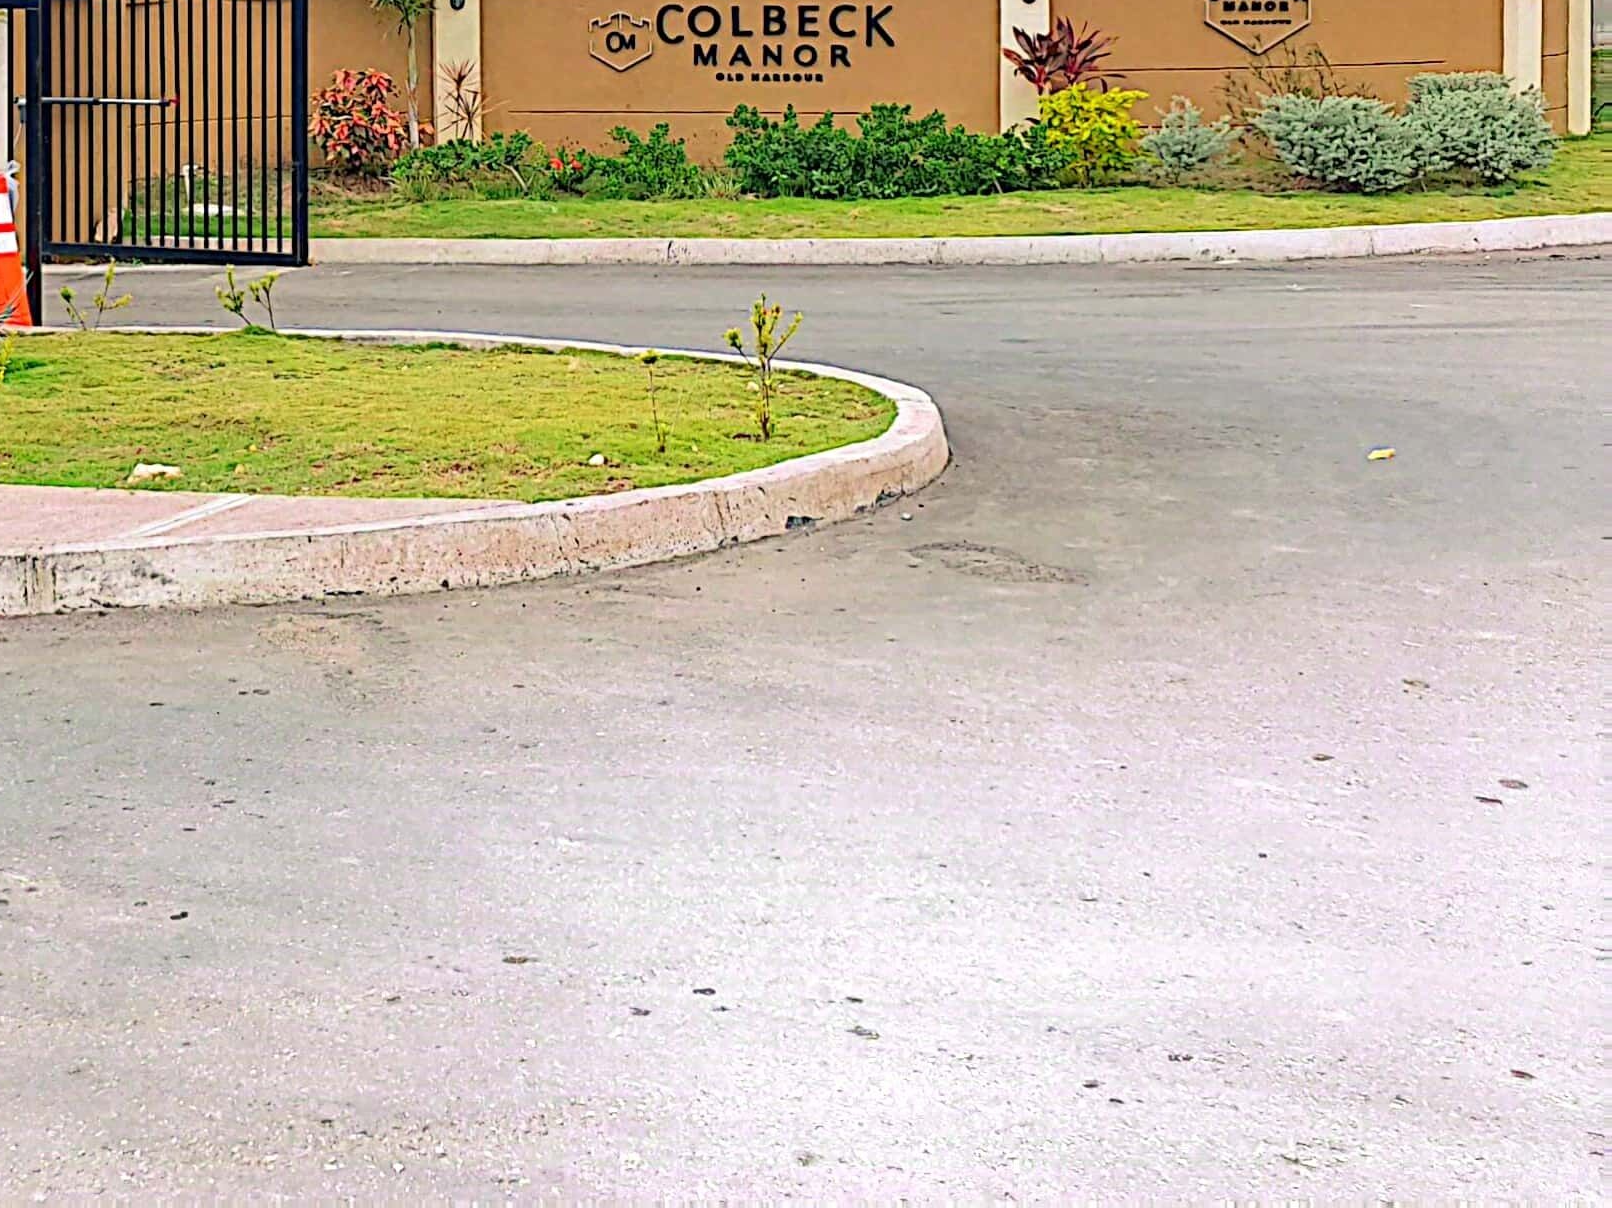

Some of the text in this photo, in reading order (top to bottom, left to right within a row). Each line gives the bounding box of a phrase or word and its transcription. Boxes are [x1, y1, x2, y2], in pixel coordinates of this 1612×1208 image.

[656, 4, 895, 47] COLBECK
[694, 44, 850, 67] MANOR
[716, 73, 823, 82] OLD HARBOUR
